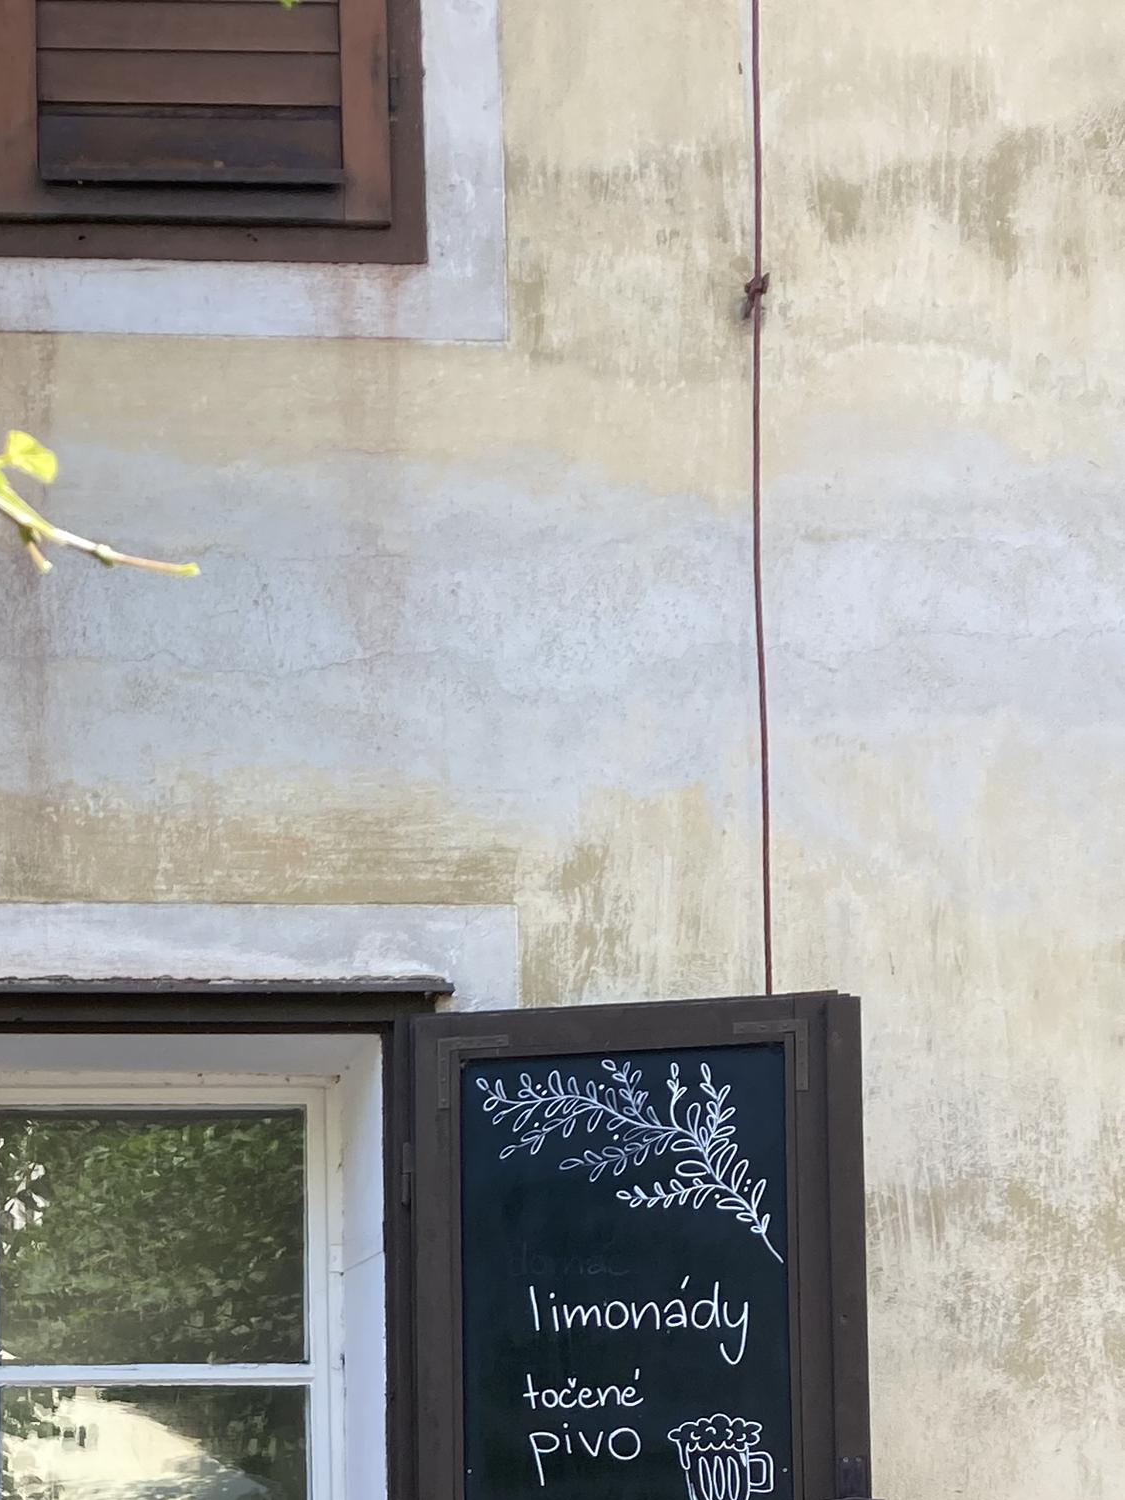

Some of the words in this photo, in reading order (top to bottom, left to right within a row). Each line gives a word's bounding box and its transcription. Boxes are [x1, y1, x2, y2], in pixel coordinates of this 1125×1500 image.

[528, 1274, 750, 1365] limonády
[523, 1368, 644, 1410] točené
[528, 1422, 642, 1487] pivo
